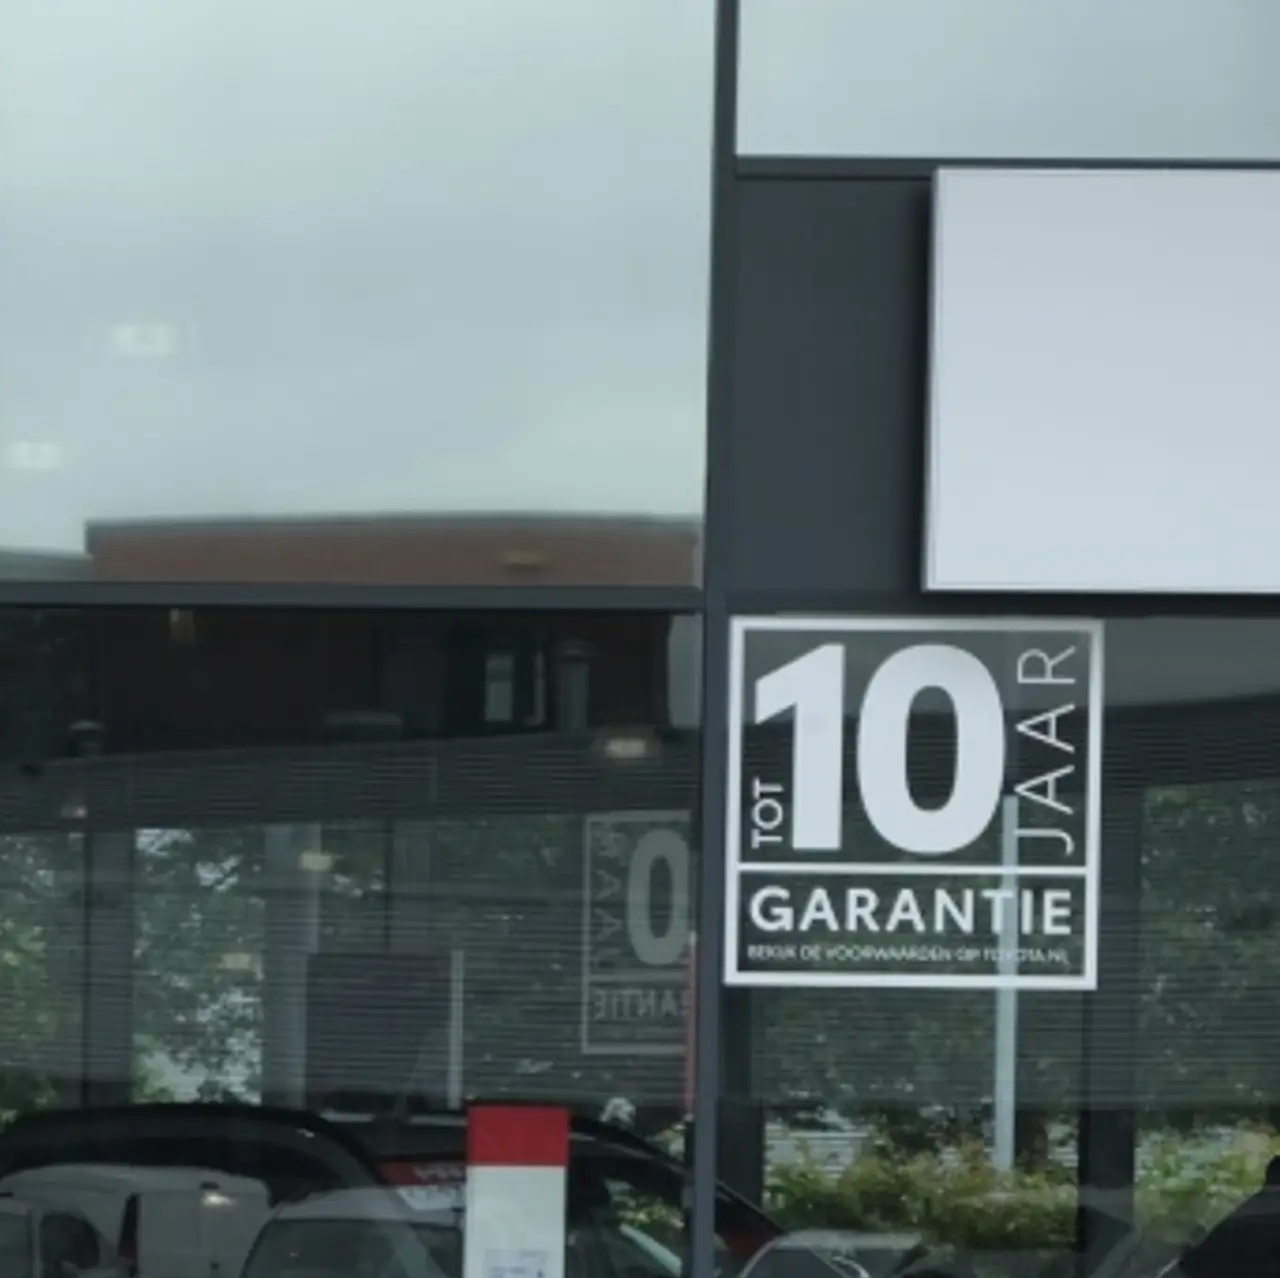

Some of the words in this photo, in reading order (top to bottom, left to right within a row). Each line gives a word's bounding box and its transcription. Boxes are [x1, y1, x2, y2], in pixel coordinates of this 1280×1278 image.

[752, 778, 784, 849] TOT
[754, 643, 1006, 855] 10
[1013, 645, 1076, 856] JAAR
[749, 885, 1073, 936] GARANTIE
